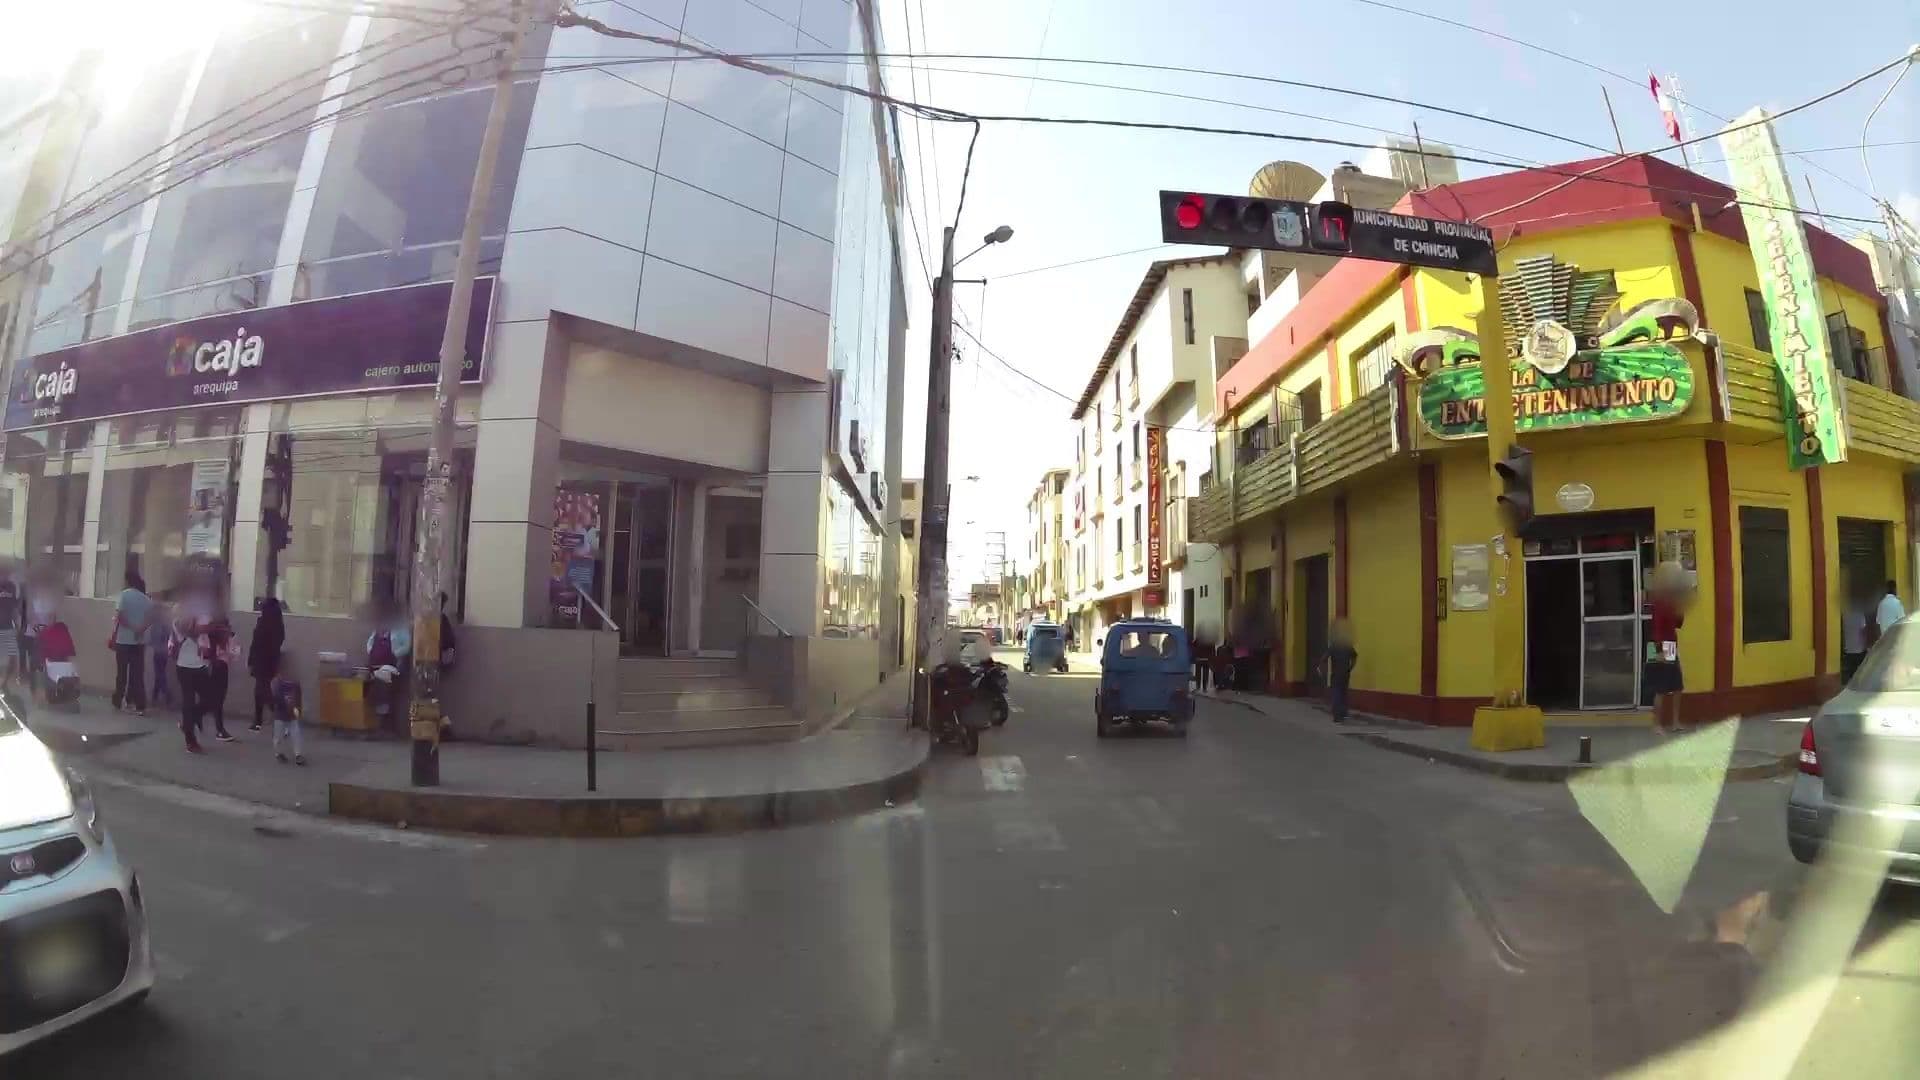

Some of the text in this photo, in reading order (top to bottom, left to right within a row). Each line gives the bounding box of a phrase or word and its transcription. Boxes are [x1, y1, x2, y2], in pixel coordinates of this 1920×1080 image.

[1353, 210, 1492, 244] MUNICIPALIDAD PROVINCIAL
[1394, 238, 1460, 260] DE CHINCHA
[194, 327, 264, 376] caja
[364, 359, 474, 378] cajero automco
[35, 361, 78, 403] caja
[193, 380, 239, 396] arequipa
[1441, 376, 1677, 426] ENTETENIMIENTO
